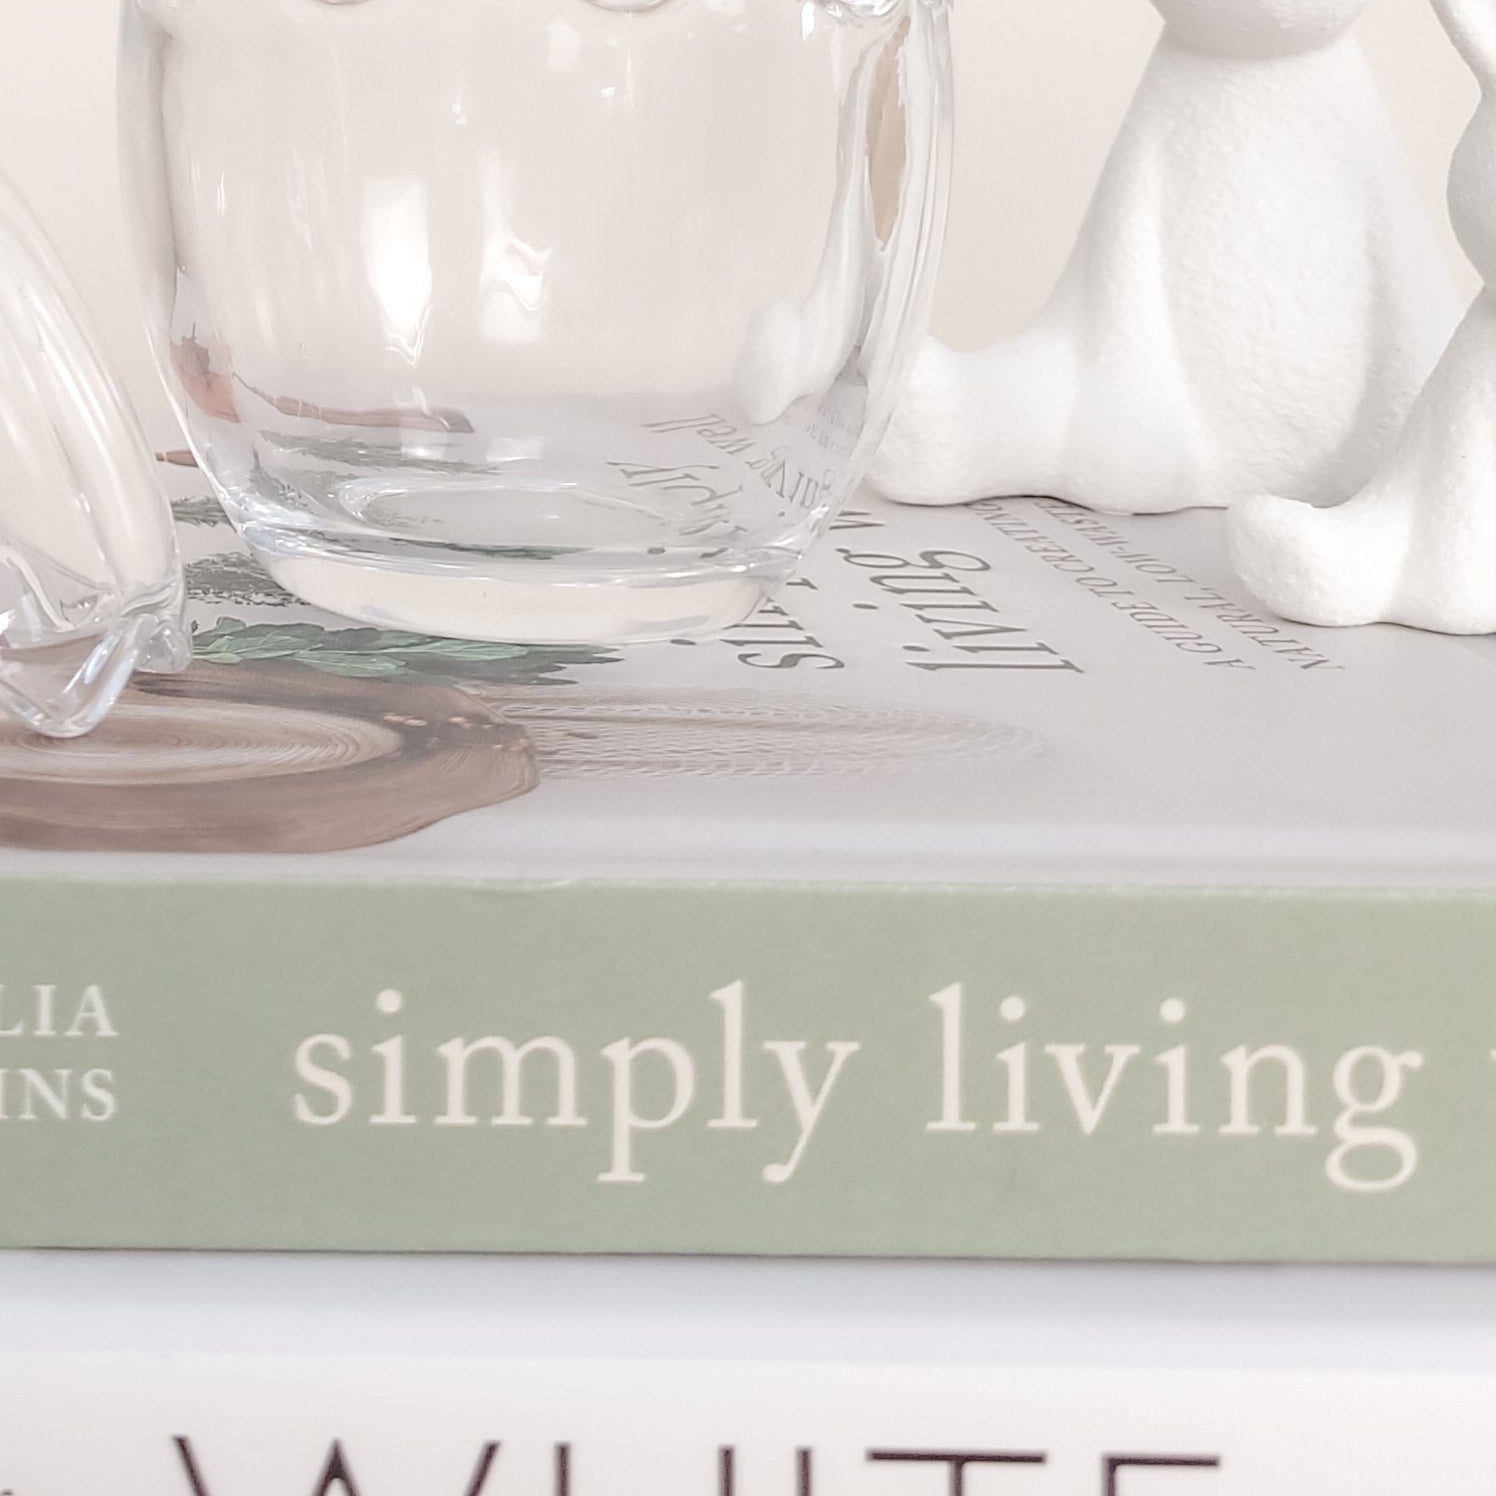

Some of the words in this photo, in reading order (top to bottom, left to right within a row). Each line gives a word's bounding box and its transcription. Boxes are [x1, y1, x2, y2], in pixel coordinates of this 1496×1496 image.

[969, 503, 1095, 573] CREATING
[836, 548, 1084, 673] living
[1075, 576, 1134, 597] TO
[1111, 601, 1222, 653] GUIDE
[1184, 587, 1346, 670] NATURAL,
[1203, 658, 1256, 670] A
[293, 978, 861, 1183] simply
[925, 981, 1423, 1192] living
